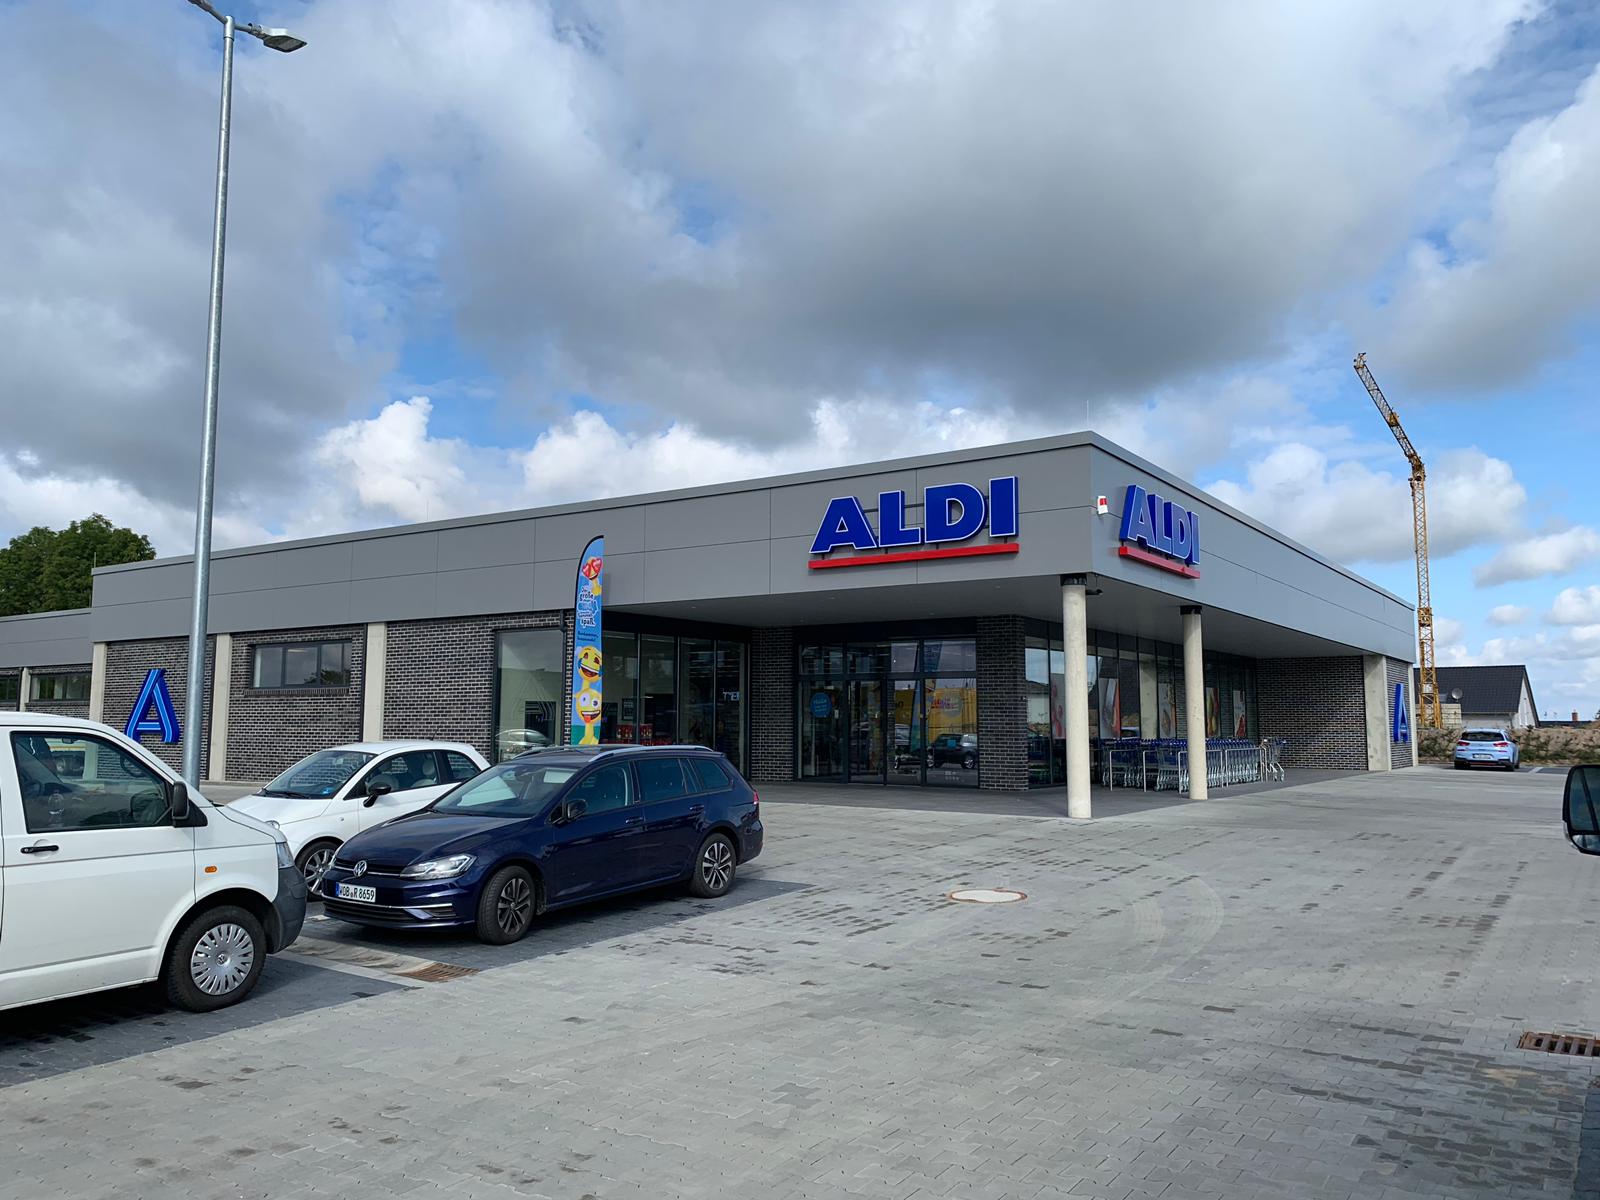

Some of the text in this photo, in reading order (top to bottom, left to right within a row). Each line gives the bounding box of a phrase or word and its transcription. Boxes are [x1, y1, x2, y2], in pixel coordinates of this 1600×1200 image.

[809, 475, 1019, 554] ALDI
[1119, 484, 1200, 565] ALDI
[124, 668, 180, 744] A
[358, 888, 375, 900] 8659
